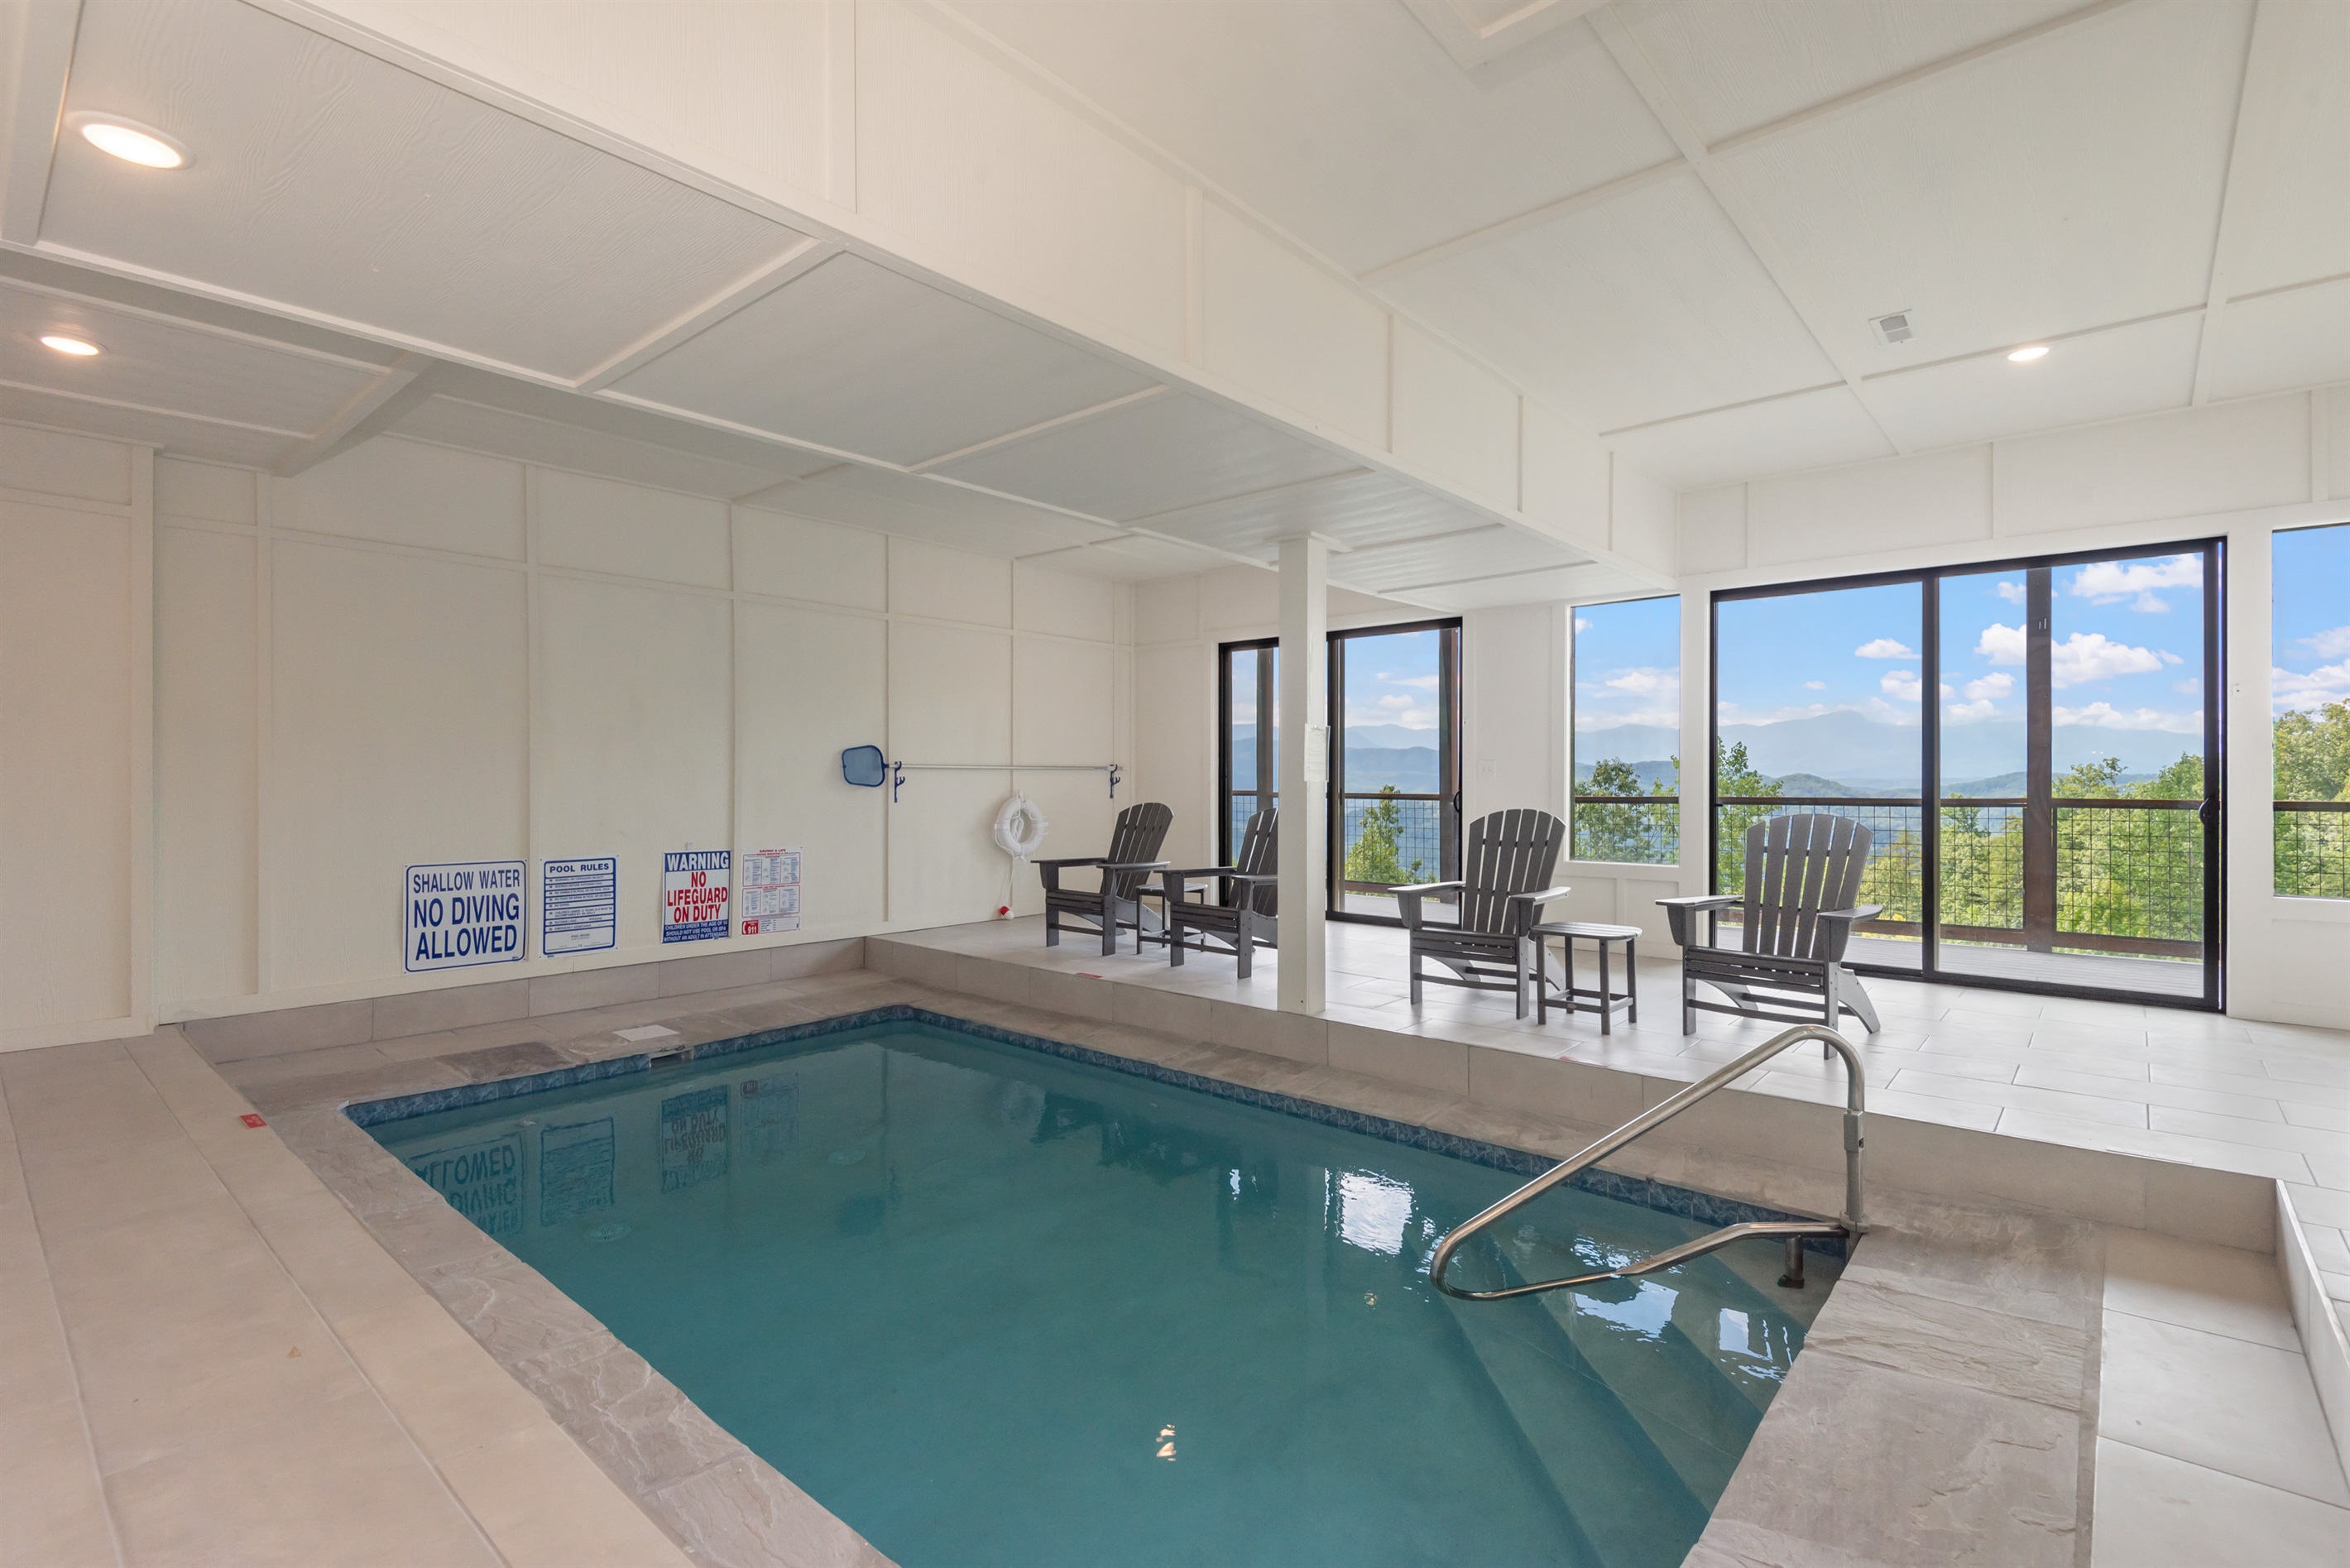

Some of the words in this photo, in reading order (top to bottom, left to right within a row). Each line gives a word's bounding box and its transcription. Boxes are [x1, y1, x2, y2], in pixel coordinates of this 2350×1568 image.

[581, 863, 609, 871] RULES
[667, 852, 729, 870] WARNING
[414, 871, 473, 894] SHALLOW
[479, 869, 520, 889] WATER
[691, 871, 707, 887] NO
[667, 887, 728, 906] LIFEGUARD
[414, 898, 444, 928] NO
[452, 893, 519, 925] DIVING
[674, 907, 689, 923] ON
[693, 904, 721, 922] DUTY
[747, 926, 757, 934] 911
[415, 924, 517, 961] ALLOWED
